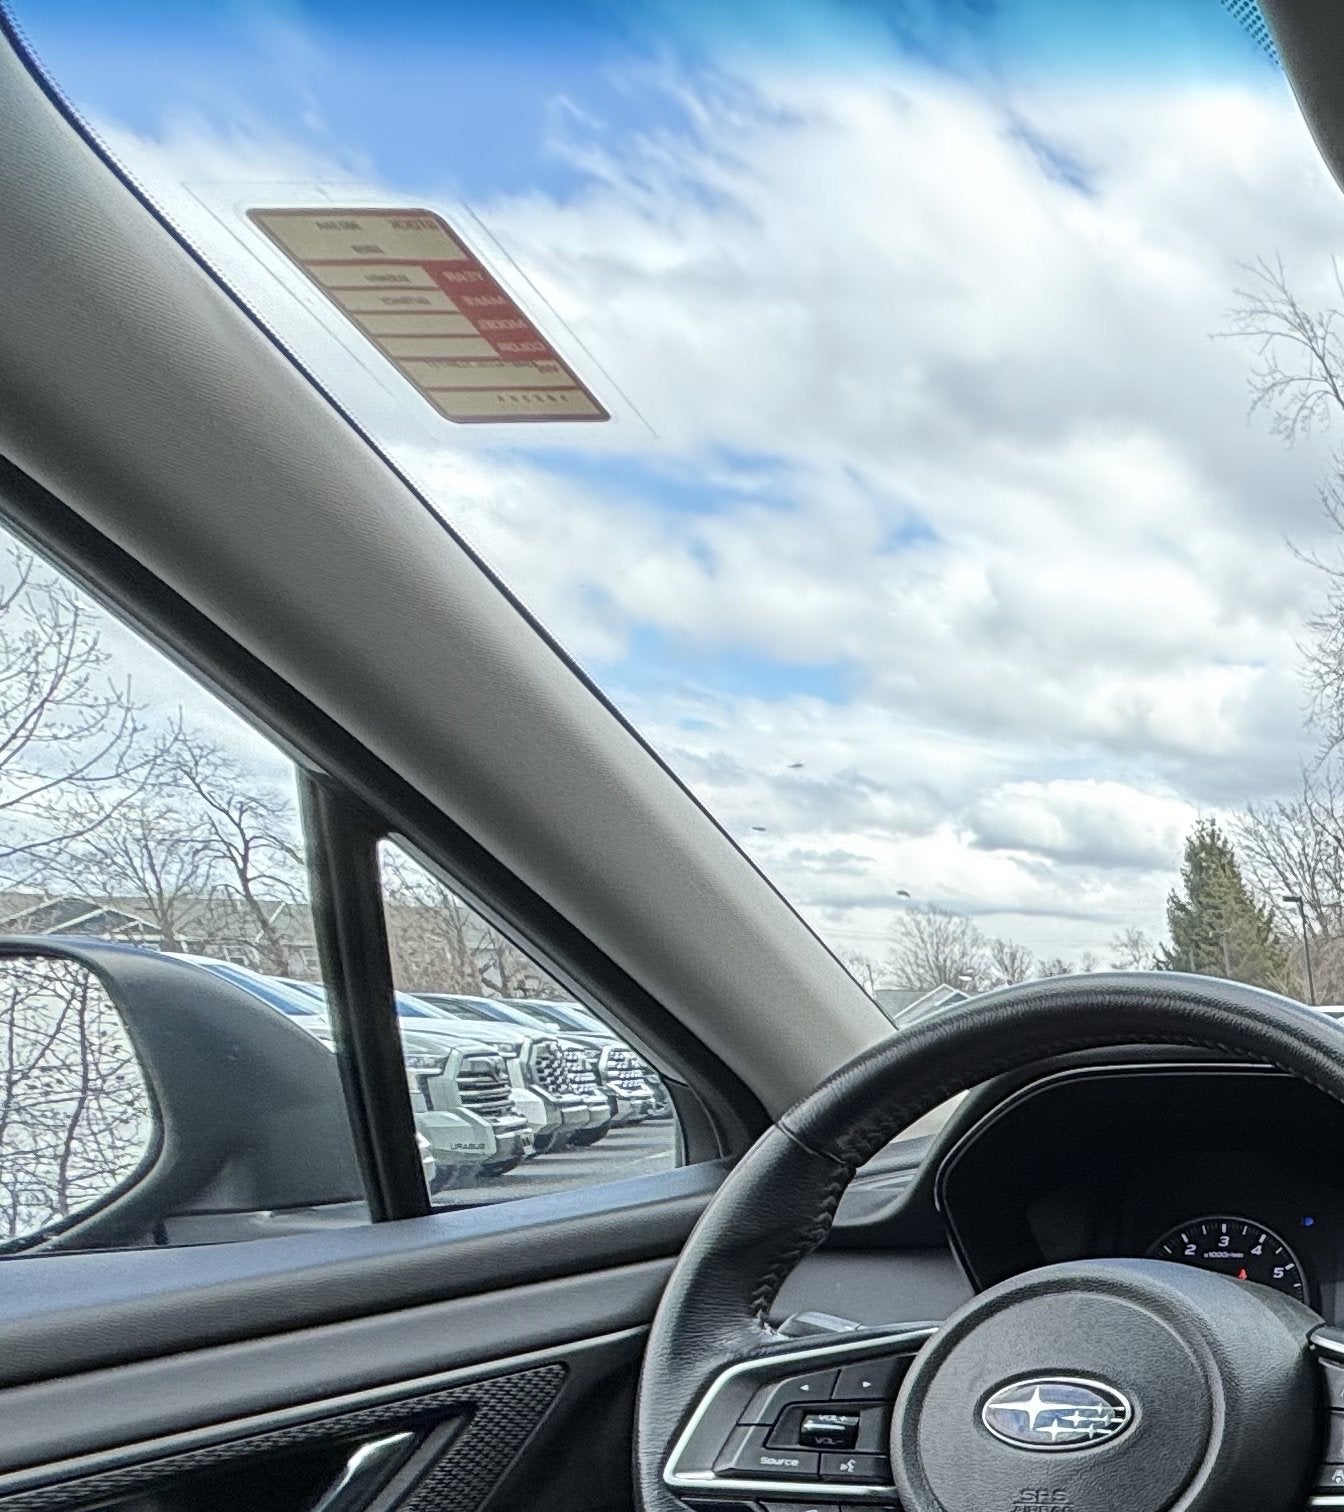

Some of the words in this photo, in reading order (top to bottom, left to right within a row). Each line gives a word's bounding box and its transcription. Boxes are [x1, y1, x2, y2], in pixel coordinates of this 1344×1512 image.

[1218, 1236, 1230, 1247] 3
[1184, 1244, 1197, 1255] 2
[1251, 1245, 1263, 1256] 4
[1273, 1267, 1284, 1279] 5
[760, 1456, 800, 1466] Source
